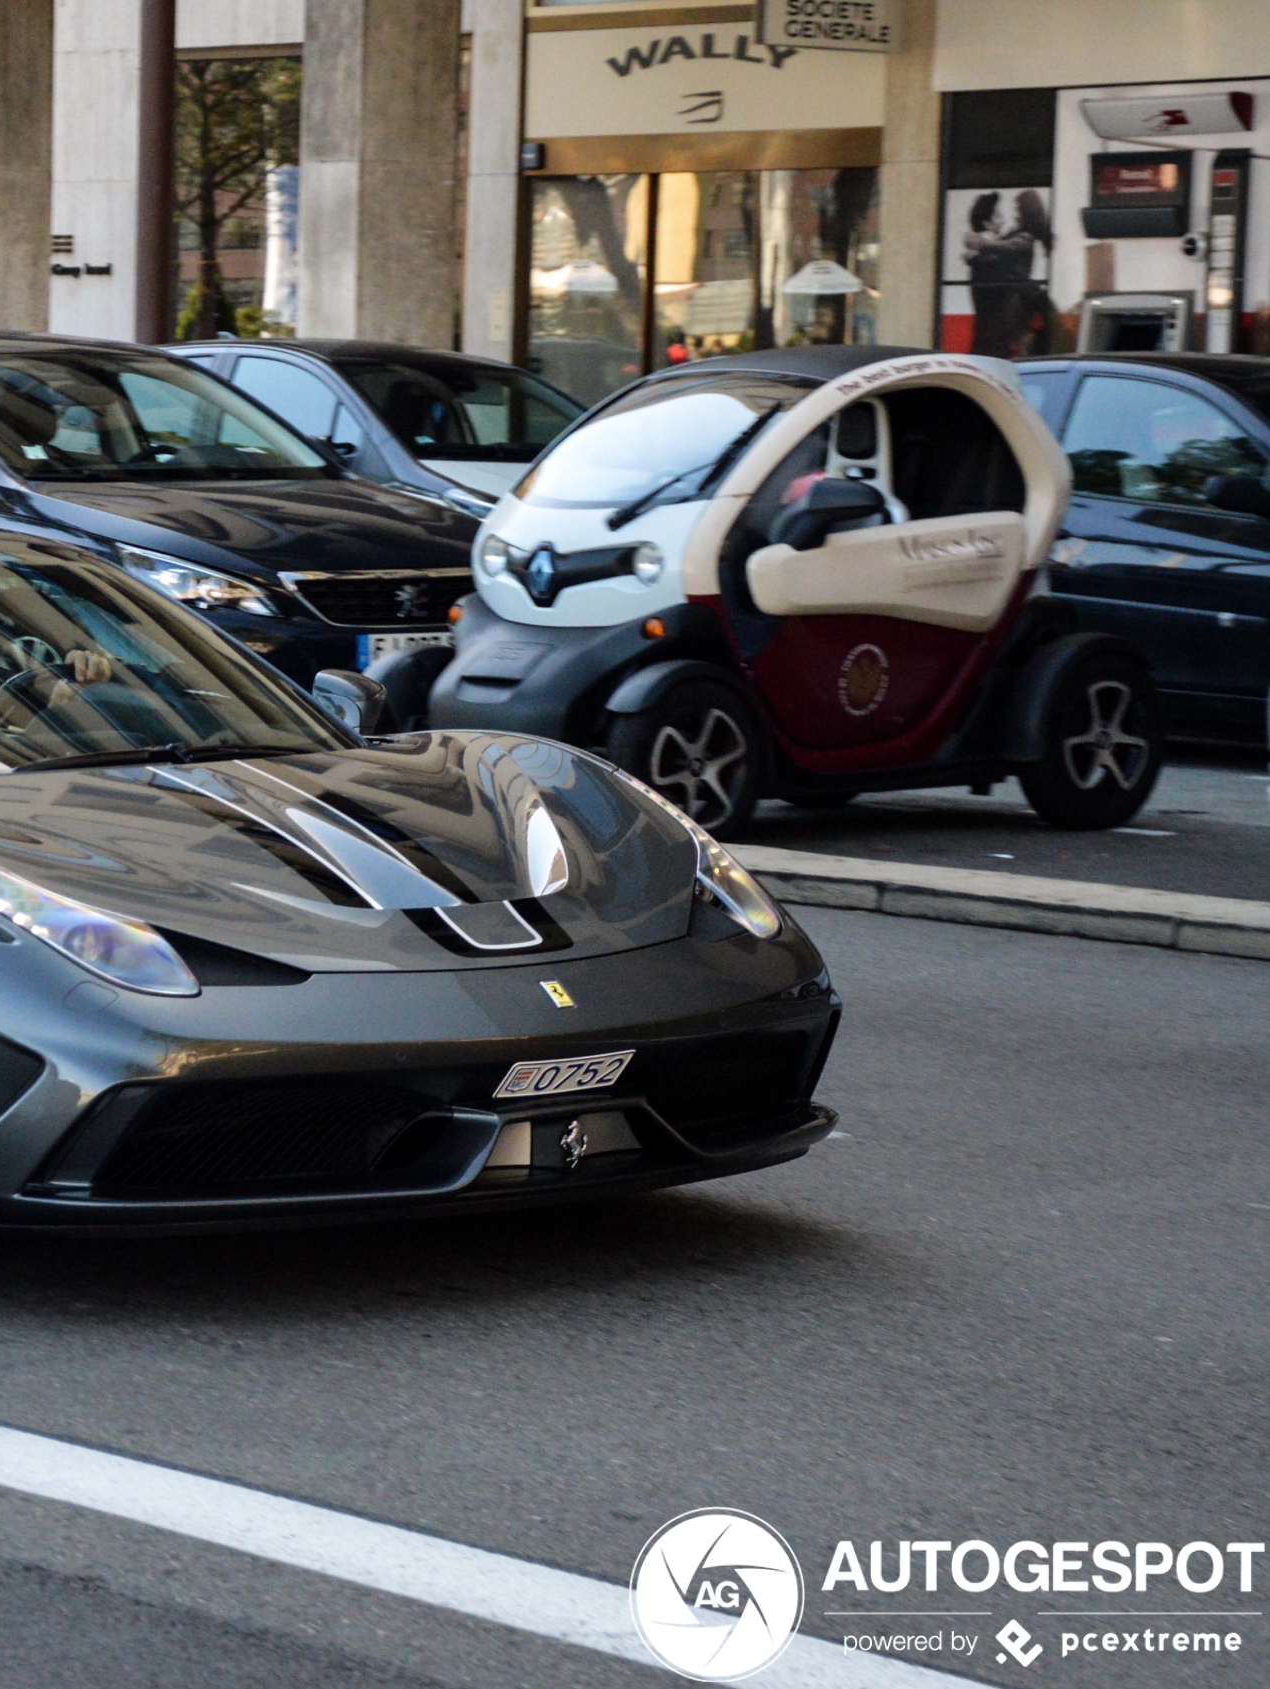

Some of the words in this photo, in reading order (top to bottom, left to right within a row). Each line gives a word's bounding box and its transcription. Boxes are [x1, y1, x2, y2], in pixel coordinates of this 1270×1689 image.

[786, 0, 875, 20] SOCIETE
[784, 20, 890, 43] GENERALE
[606, 33, 798, 77] WALLY
[533, 1057, 624, 1092] 0752
